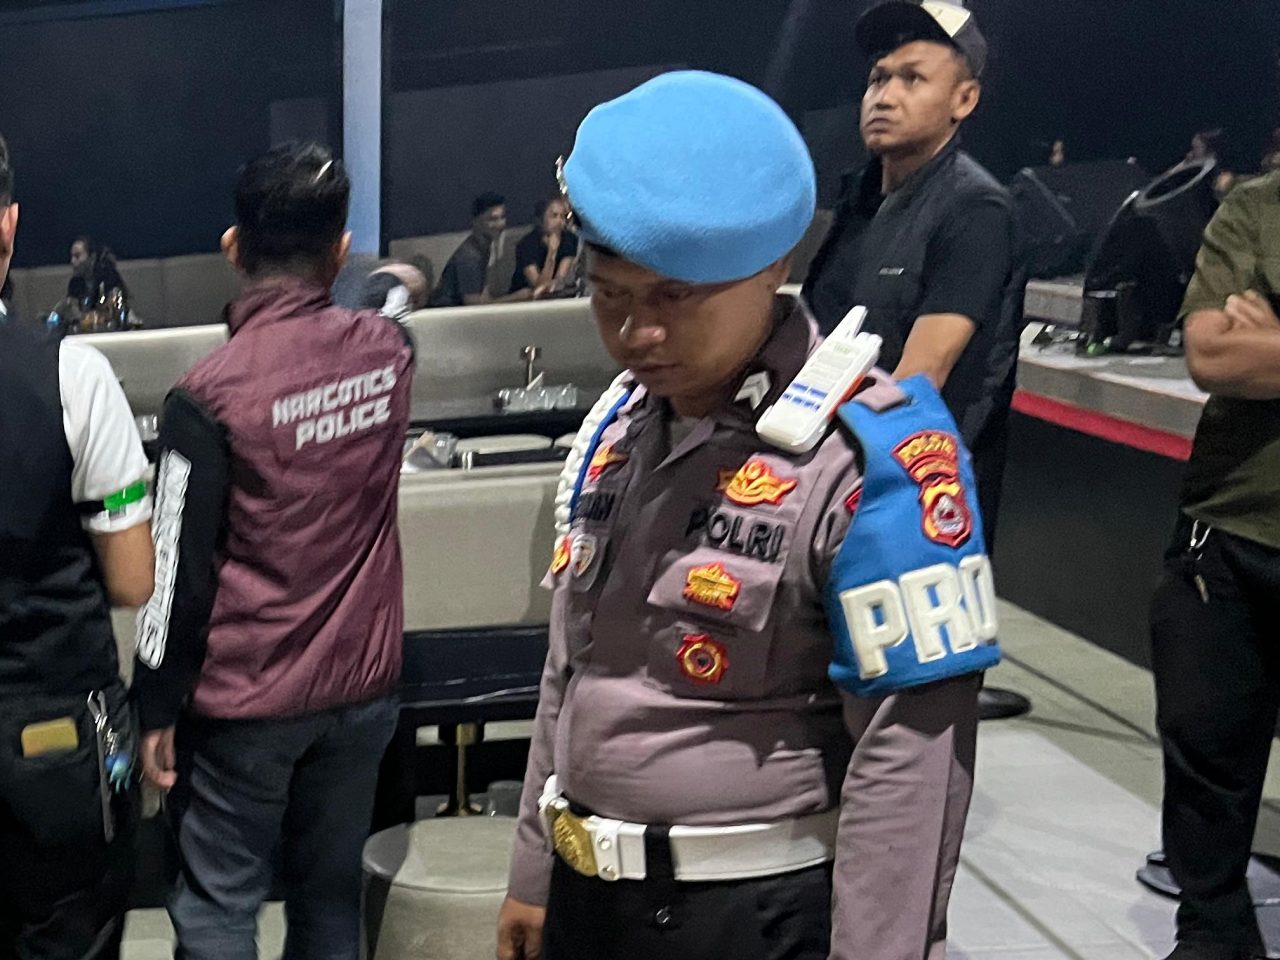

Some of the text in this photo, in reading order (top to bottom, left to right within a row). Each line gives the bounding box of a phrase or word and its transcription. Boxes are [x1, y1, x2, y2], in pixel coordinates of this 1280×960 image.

[272, 364, 397, 429] NARCOTICS
[296, 394, 392, 450] POLICE
[685, 507, 786, 563] POLRI
